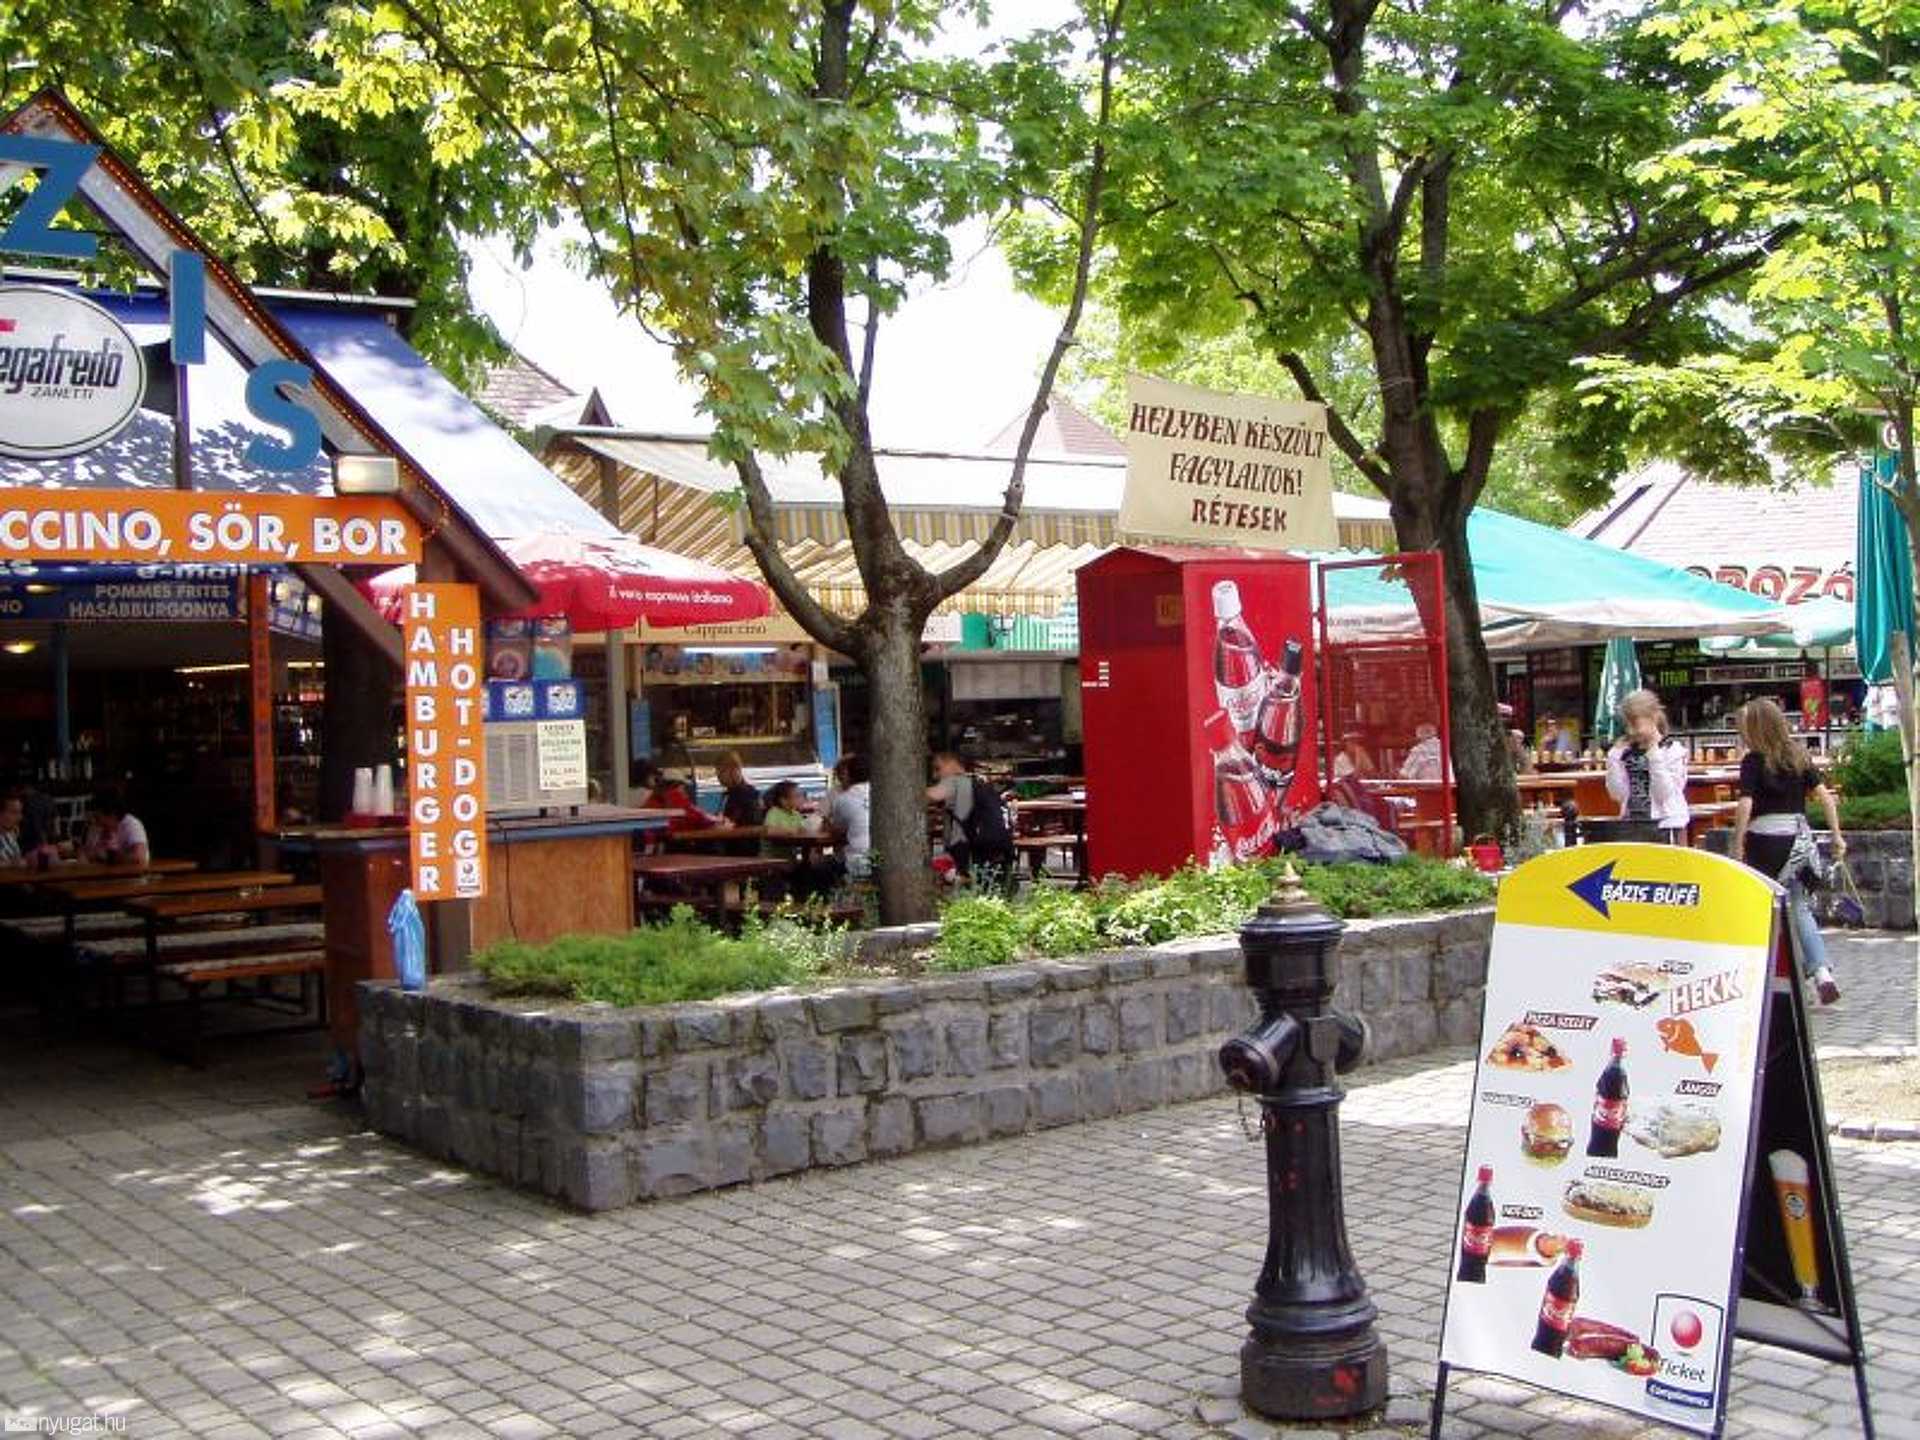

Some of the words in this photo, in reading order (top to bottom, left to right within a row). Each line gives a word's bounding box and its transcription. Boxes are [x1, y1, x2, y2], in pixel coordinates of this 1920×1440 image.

[30, 386, 95, 400] ZANETTI
[1130, 402, 1242, 446] HELYBEN
[1170, 452, 1303, 497] FAGYLALTOK!
[189, 501, 299, 559] SÖR,
[312, 517, 407, 556] BOR
[1192, 494, 1288, 532] RÉTESEK
[95, 584, 172, 599] POMMES
[177, 585, 231, 599] FRITES
[407, 592, 441, 892] HAMBURGER
[450, 627, 478, 859] HOT-DOG
[1602, 879, 1650, 902] BÁZIS
[1670, 963, 1744, 1016] HEKK
